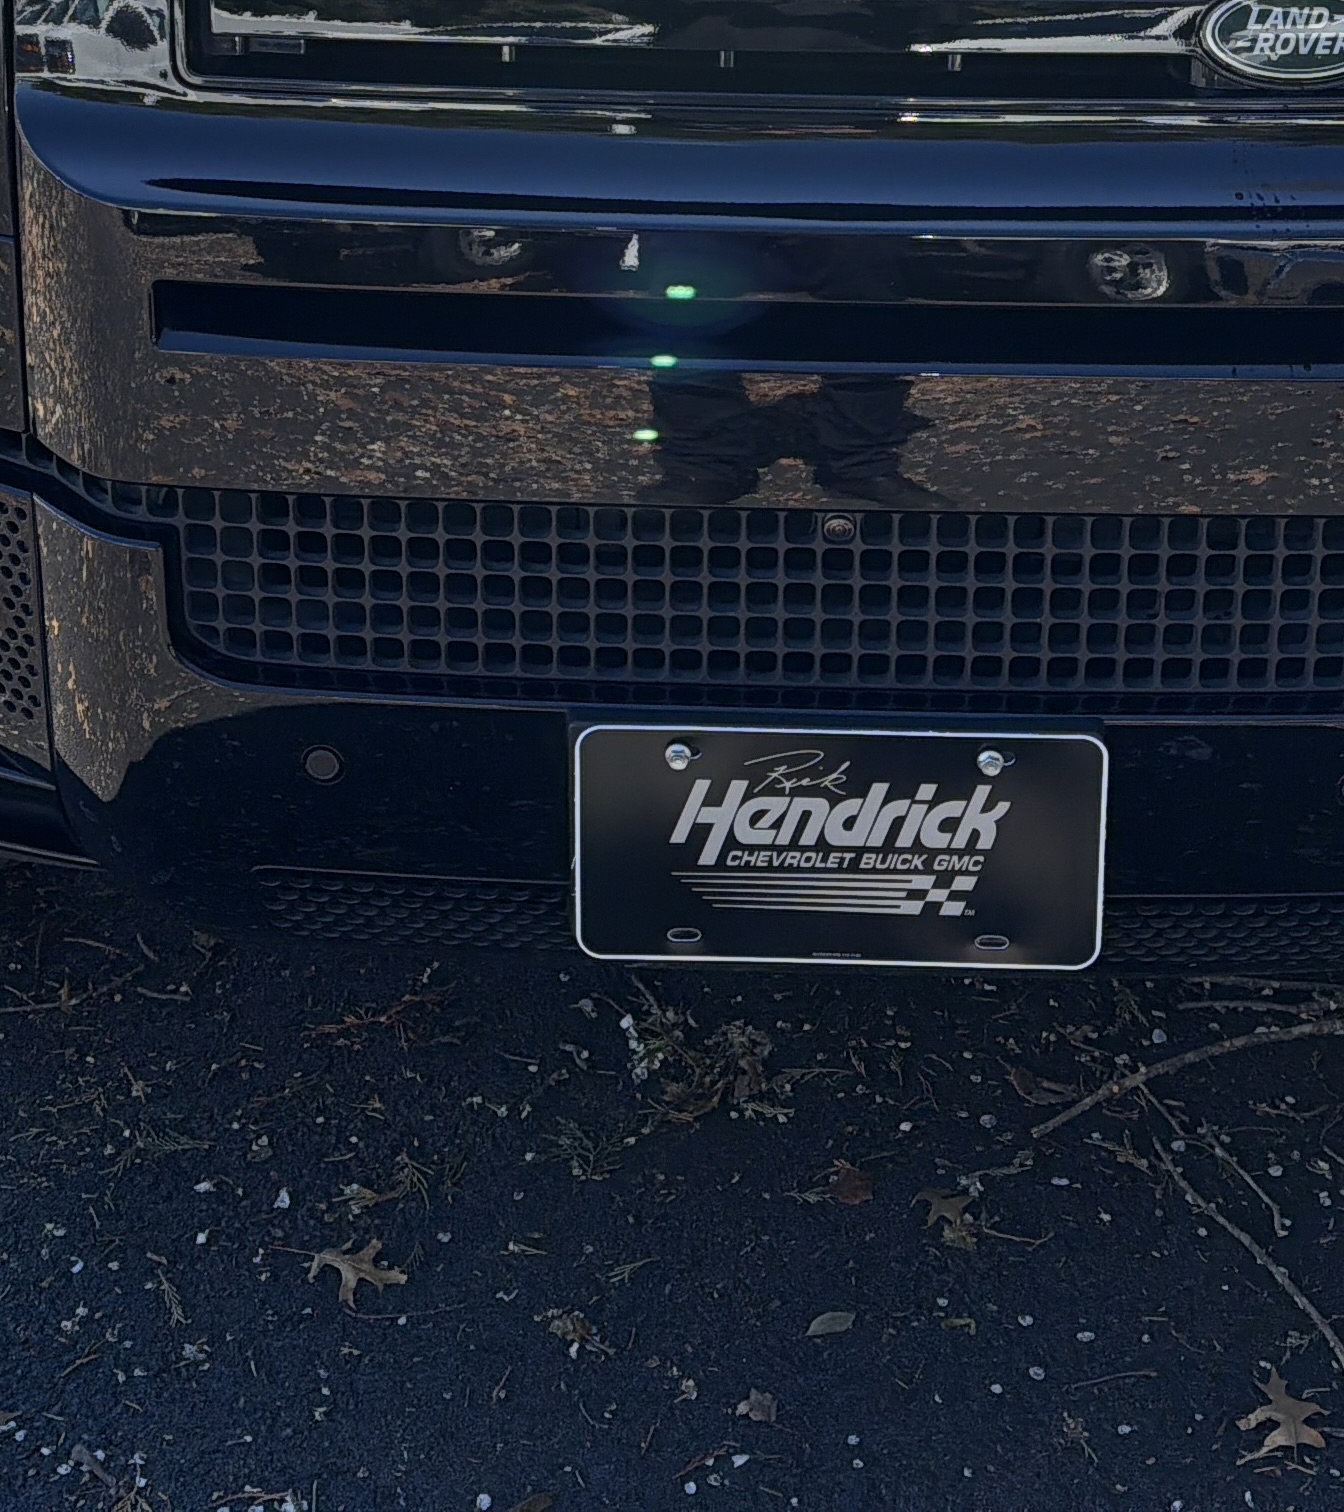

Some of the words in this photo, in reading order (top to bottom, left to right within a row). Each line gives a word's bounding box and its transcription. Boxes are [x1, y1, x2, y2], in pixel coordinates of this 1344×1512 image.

[1246, 5, 1330, 30] LAND
[668, 778, 1012, 867] Hendrick
[725, 850, 856, 869] CHEVROLET
[859, 852, 929, 871] BUICK
[932, 854, 986, 873] GMC
